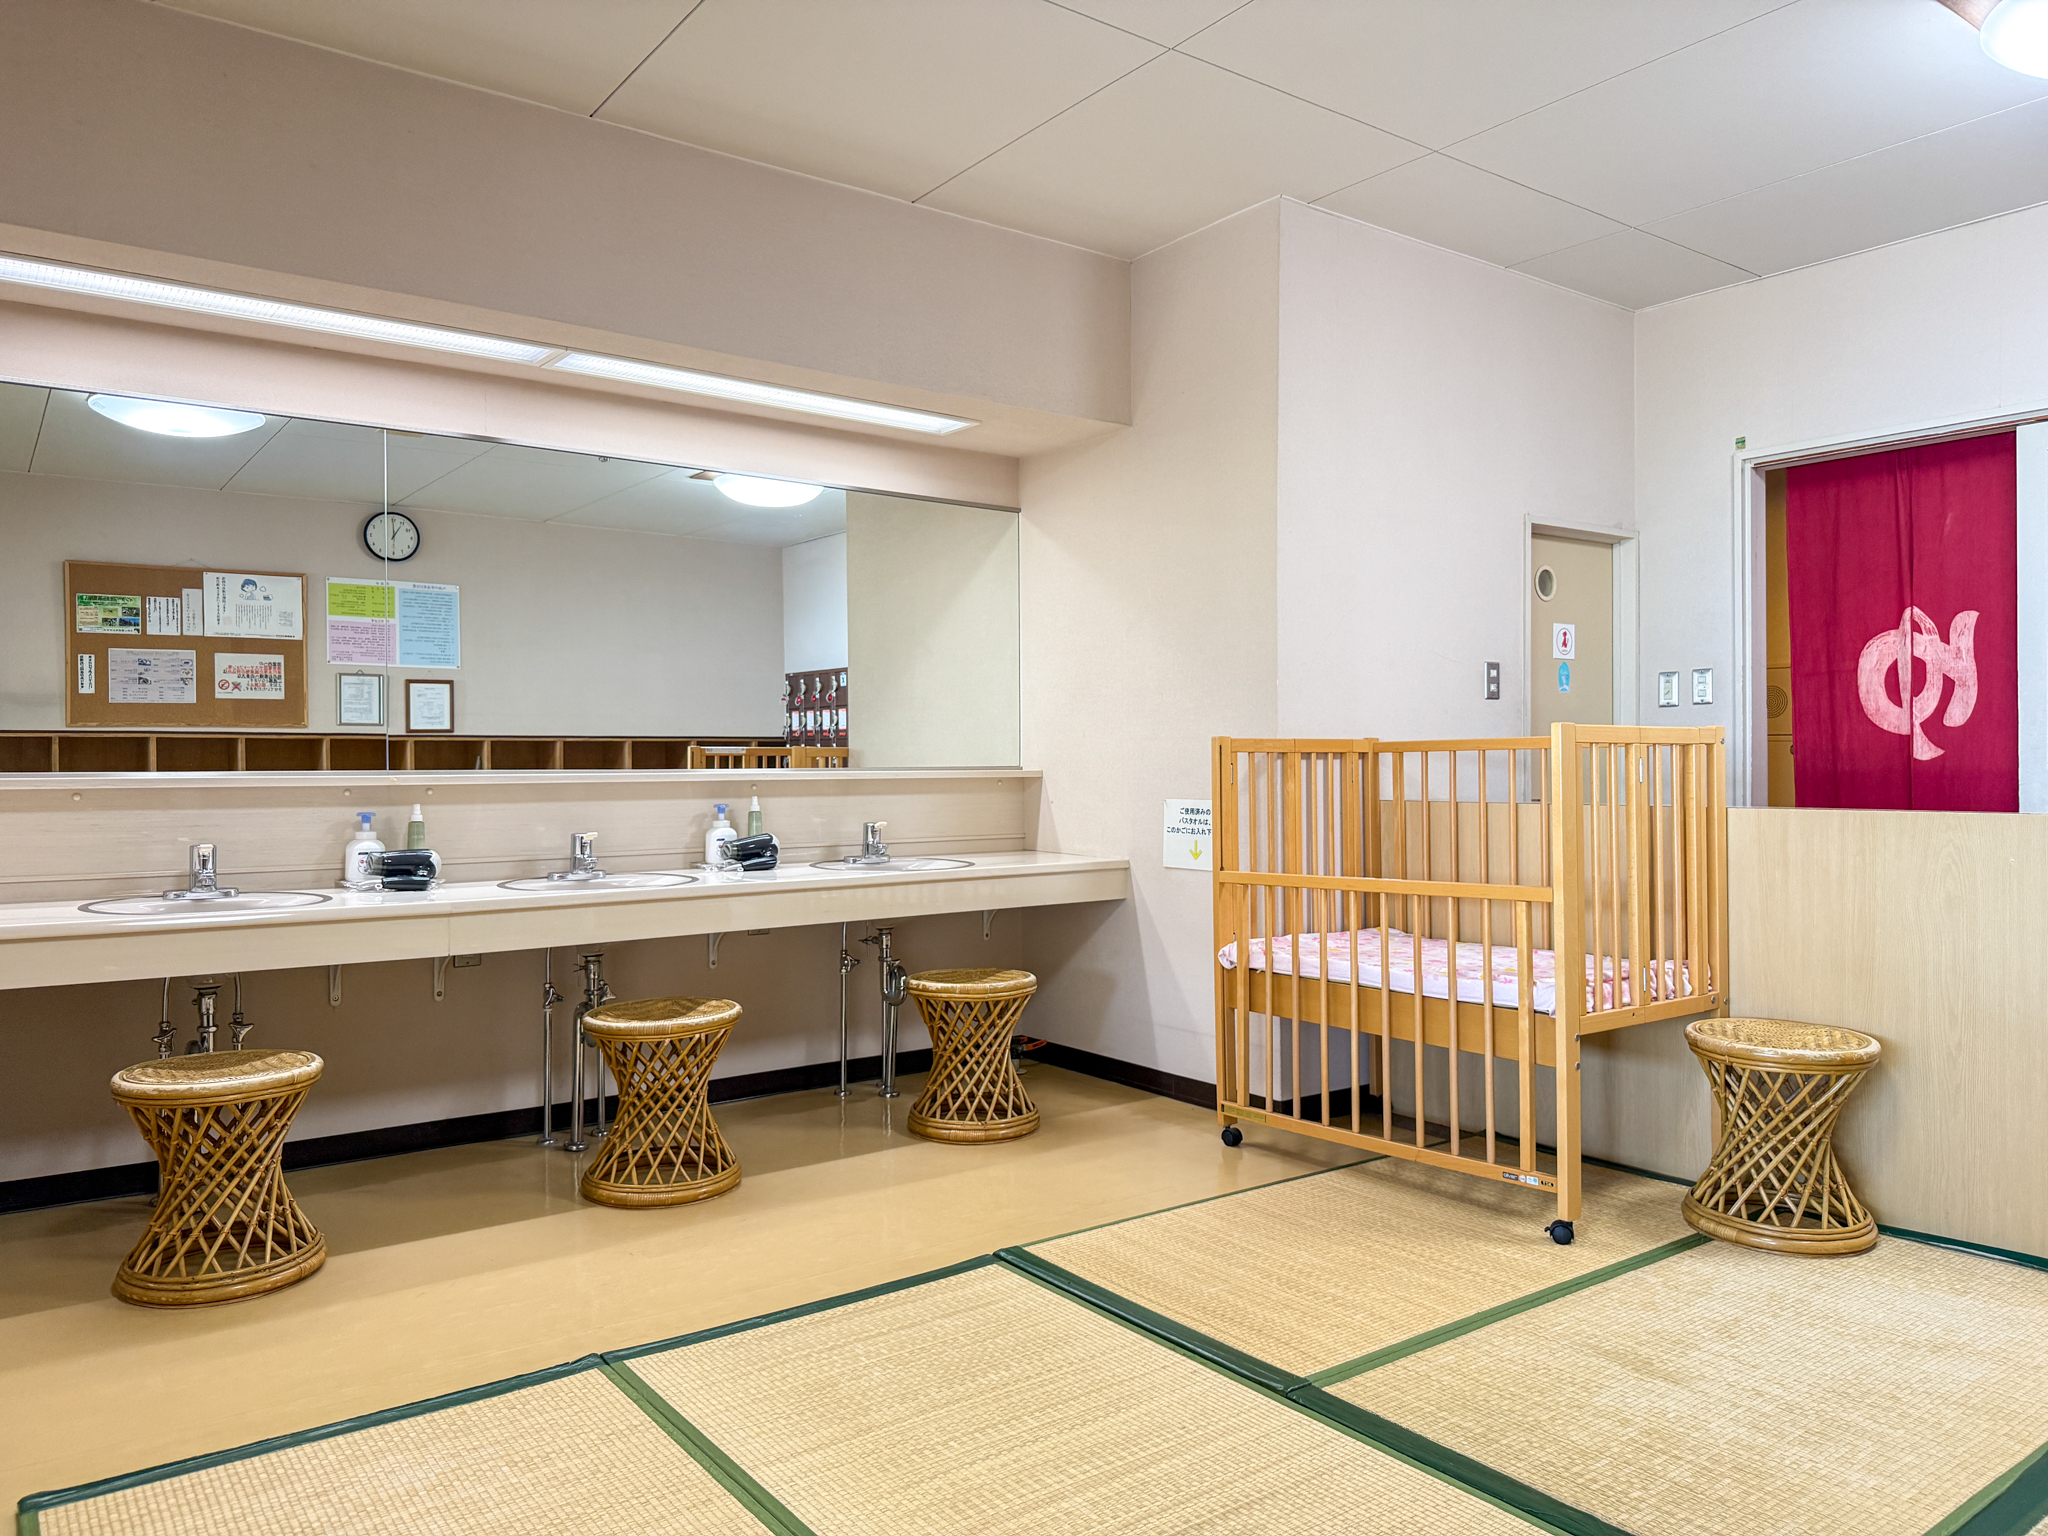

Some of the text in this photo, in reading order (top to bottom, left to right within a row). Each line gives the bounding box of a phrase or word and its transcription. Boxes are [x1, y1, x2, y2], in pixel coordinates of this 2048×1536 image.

[1179, 807, 1211, 816] ご使用済みの
